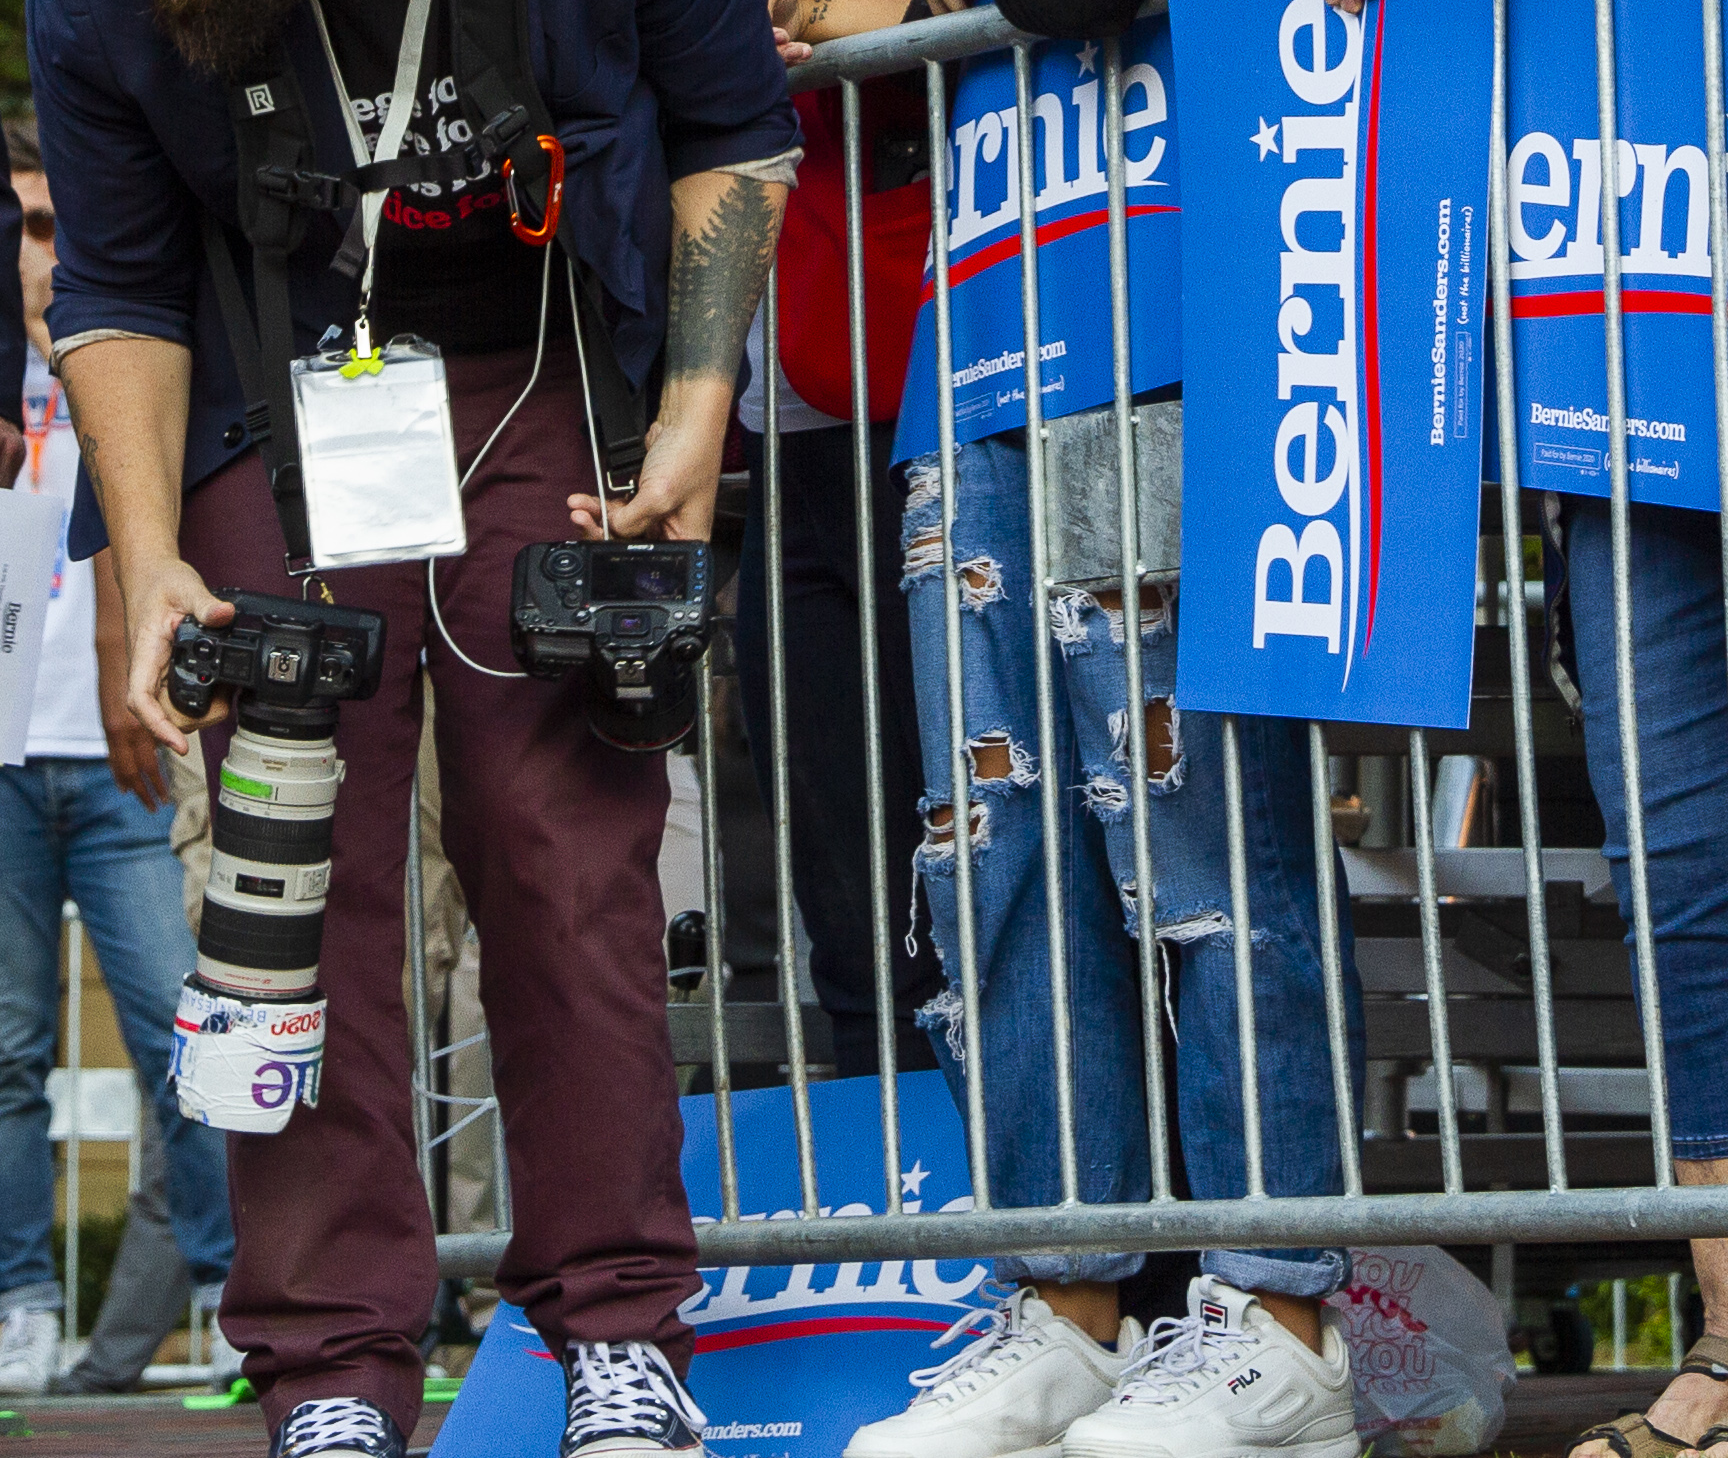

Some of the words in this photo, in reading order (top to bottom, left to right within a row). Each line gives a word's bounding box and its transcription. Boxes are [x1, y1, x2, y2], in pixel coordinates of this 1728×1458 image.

[1430, 198, 1452, 446] BernieSanders.com
[1531, 403, 1686, 442] BernieSaners.com
[1227, 1368, 1262, 1395] FILA
